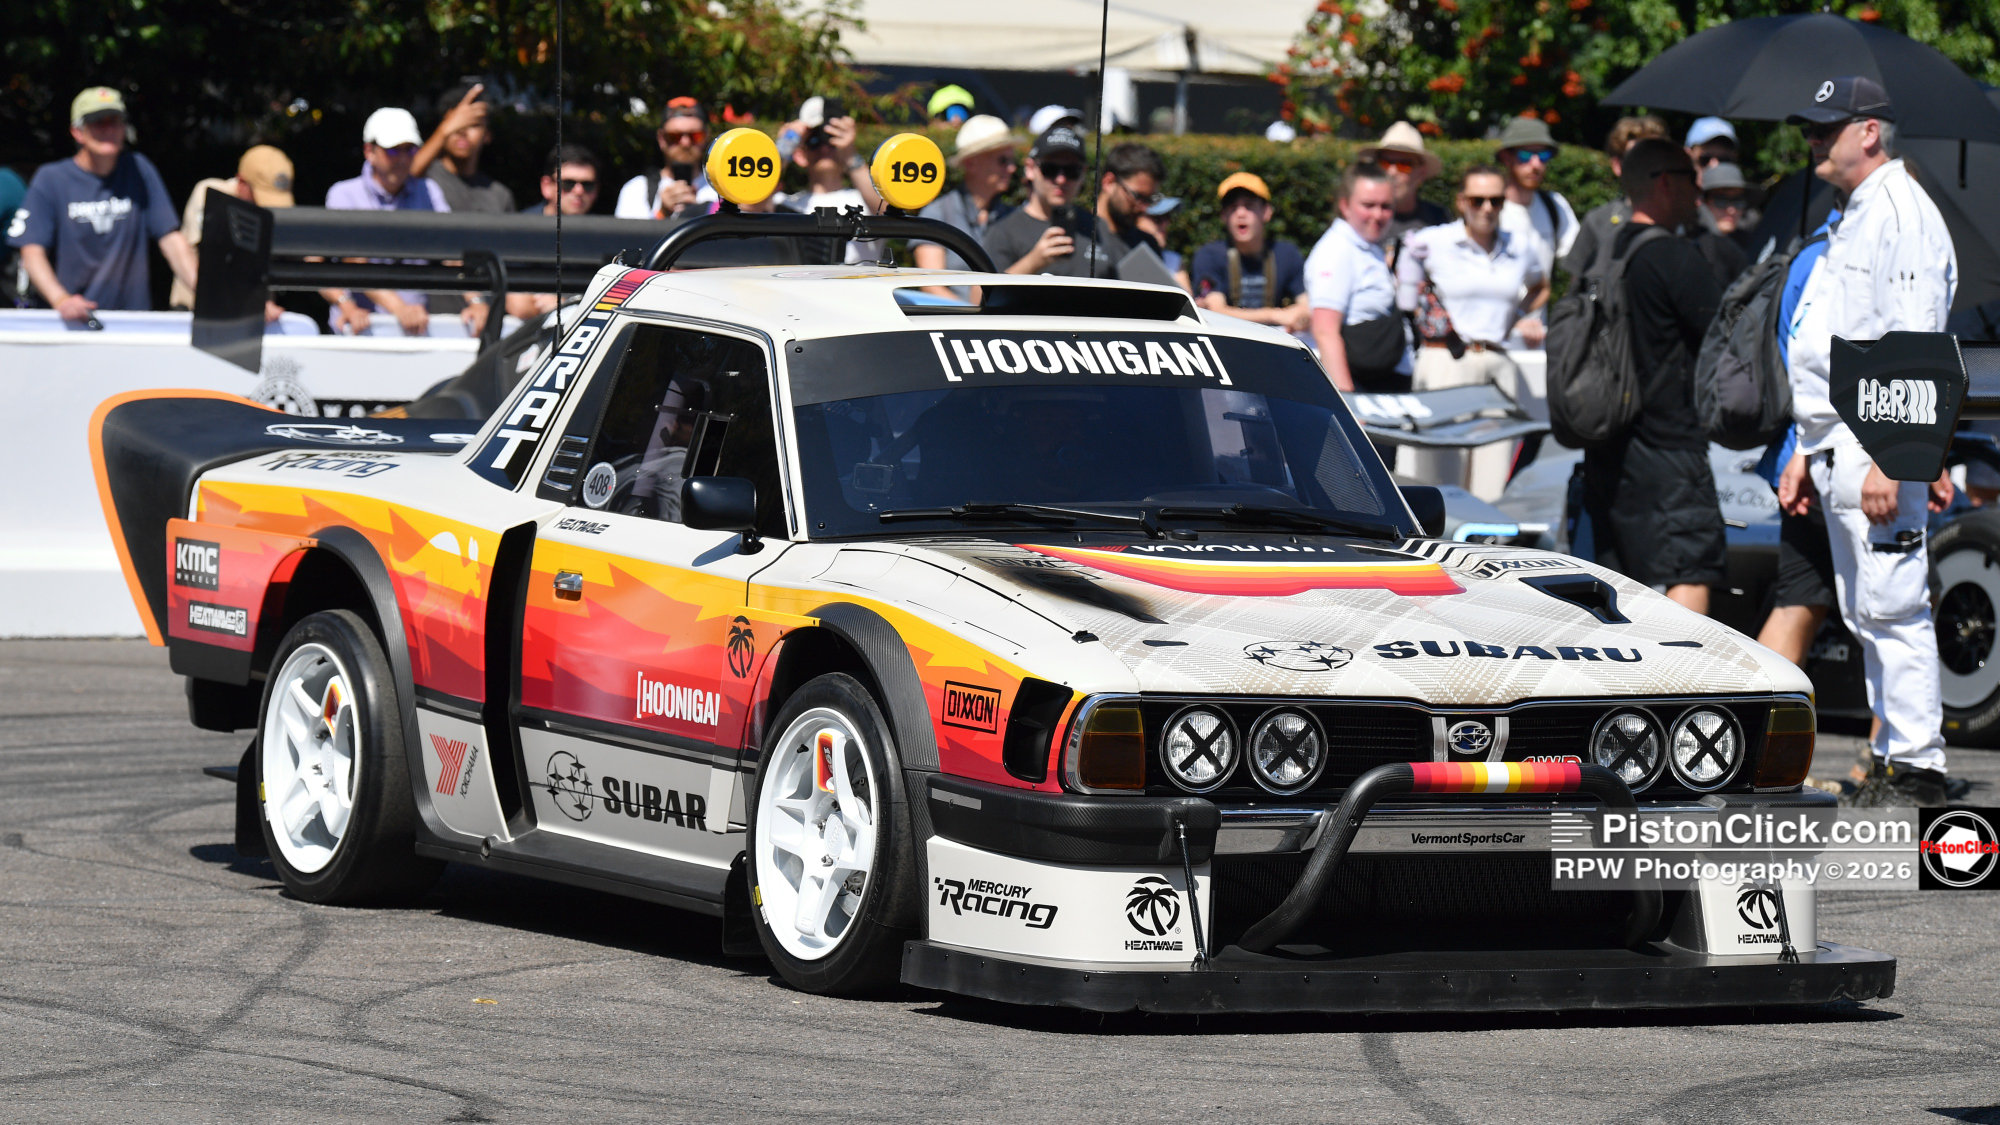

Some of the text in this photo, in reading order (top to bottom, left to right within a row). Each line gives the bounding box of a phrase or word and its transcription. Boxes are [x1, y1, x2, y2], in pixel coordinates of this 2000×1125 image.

[728, 156, 773, 178] 199
[891, 161, 937, 183] 199
[490, 326, 601, 470] BRAT
[1858, 379, 1910, 423] H&R
[589, 473, 610, 496] 408
[176, 543, 218, 575] KMC
[176, 573, 217, 586] WHEELS
[1373, 640, 1643, 663] SUBARU
[947, 689, 994, 724] DIXXON
[459, 745, 480, 800] YOKOHAMA
[1410, 832, 1526, 846] VermontSportsCar
[967, 878, 1032, 898] MERCURY
[934, 876, 1058, 929] Racing
[1124, 940, 1183, 951] HEATWAVE
[1737, 933, 1784, 944] HEATWAV
